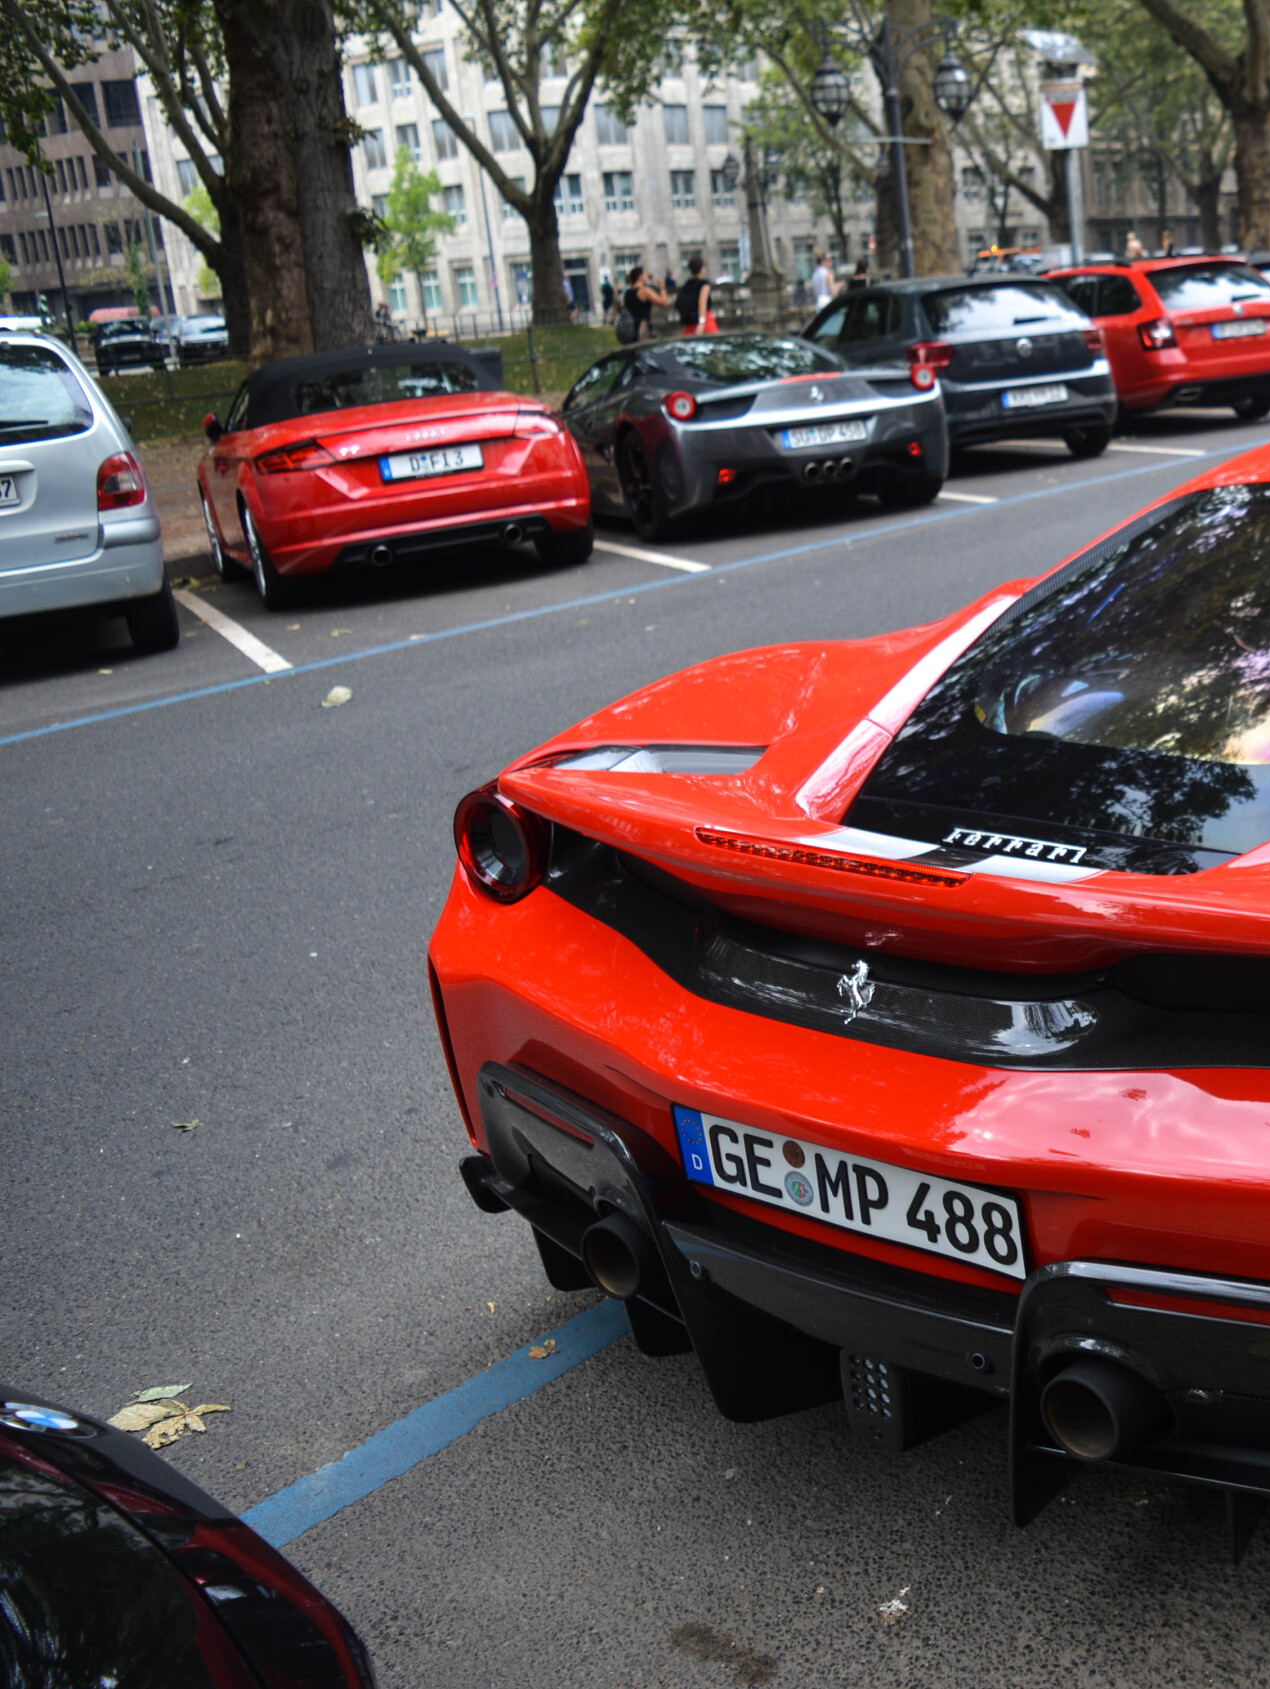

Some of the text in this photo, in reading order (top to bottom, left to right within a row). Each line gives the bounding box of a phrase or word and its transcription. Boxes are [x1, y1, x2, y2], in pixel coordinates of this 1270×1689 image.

[408, 455, 420, 472] D
[942, 827, 1088, 864] Ferrari
[691, 1153, 704, 1171] D
[708, 1123, 1018, 1266] GE MP 488
